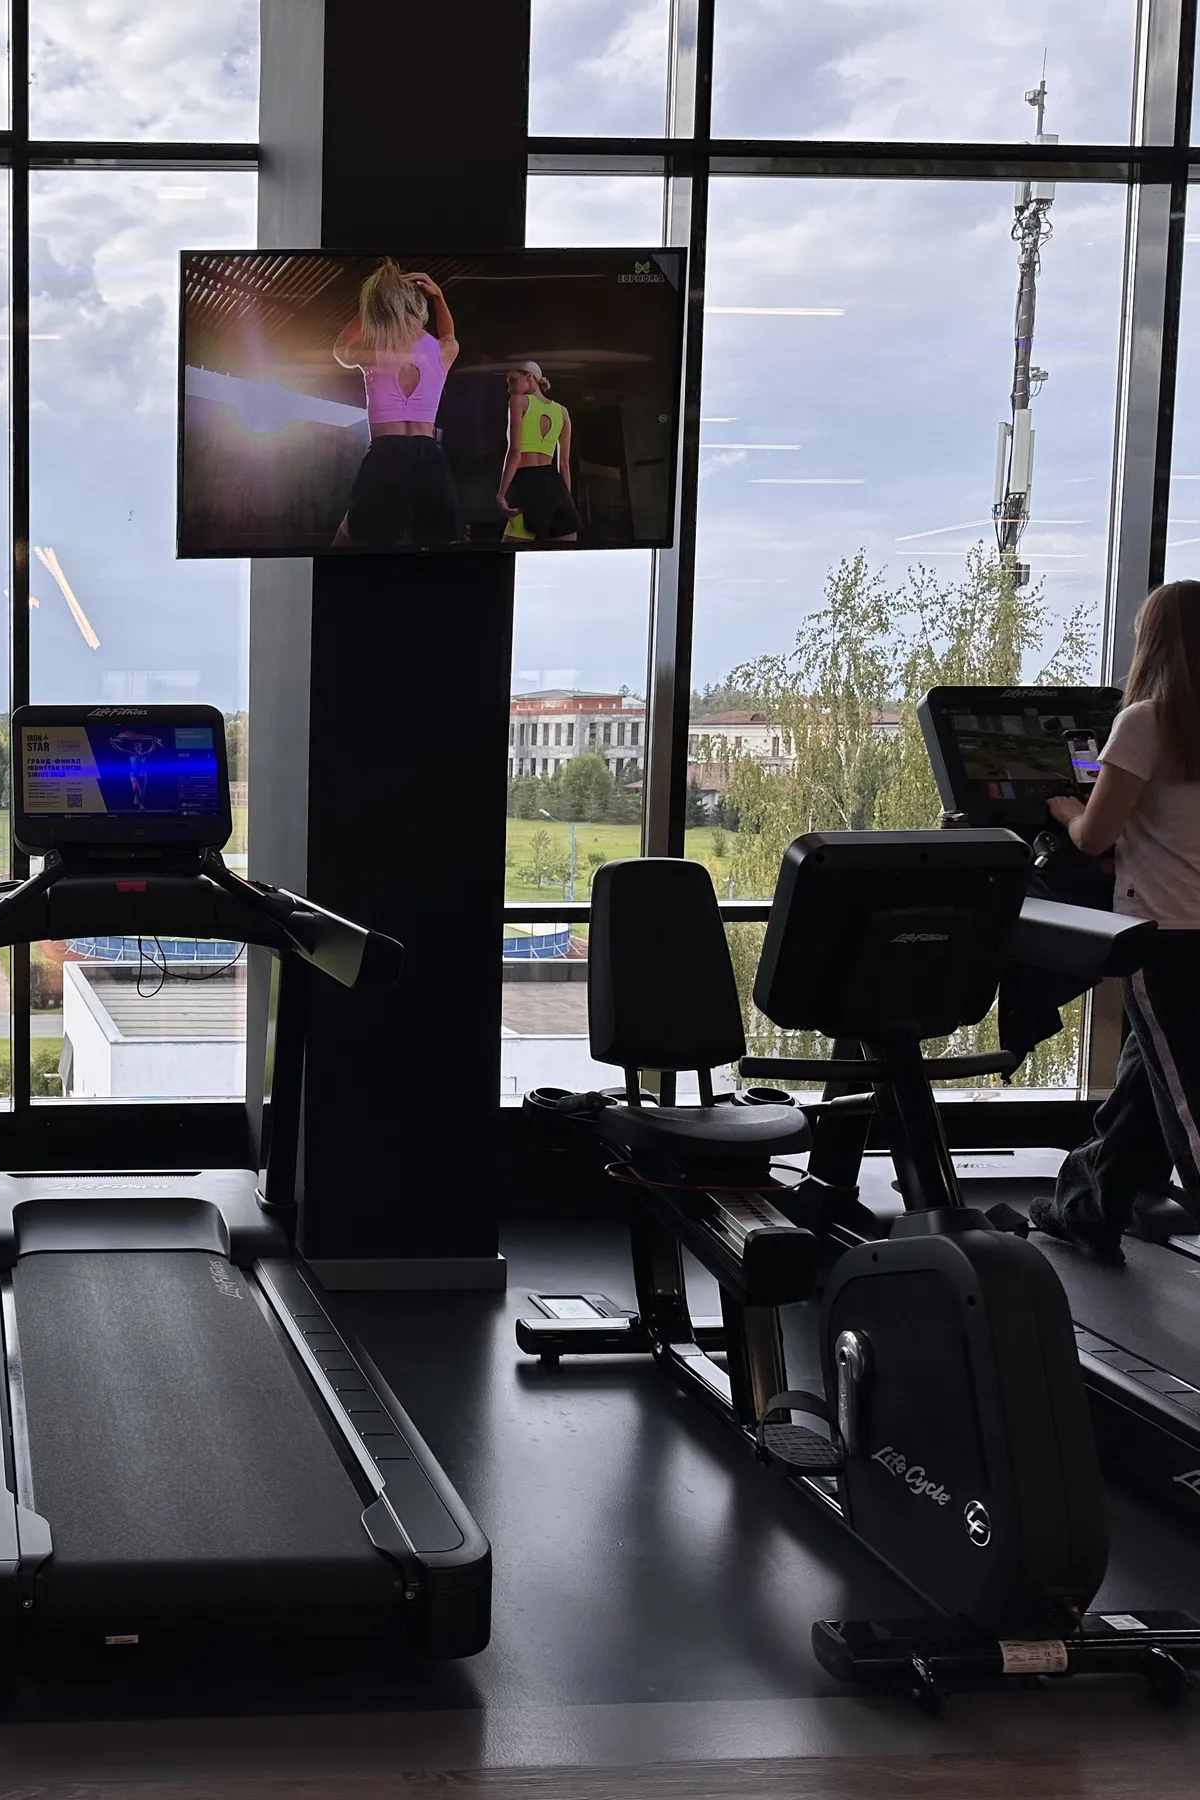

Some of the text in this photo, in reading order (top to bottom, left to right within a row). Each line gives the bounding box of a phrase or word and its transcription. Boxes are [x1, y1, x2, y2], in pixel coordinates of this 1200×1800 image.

[618, 273, 665, 283] EUPHORIA
[26, 734, 43, 742] IRON
[26, 742, 50, 752] STAR
[870, 1445, 952, 1507] Life Cycle
